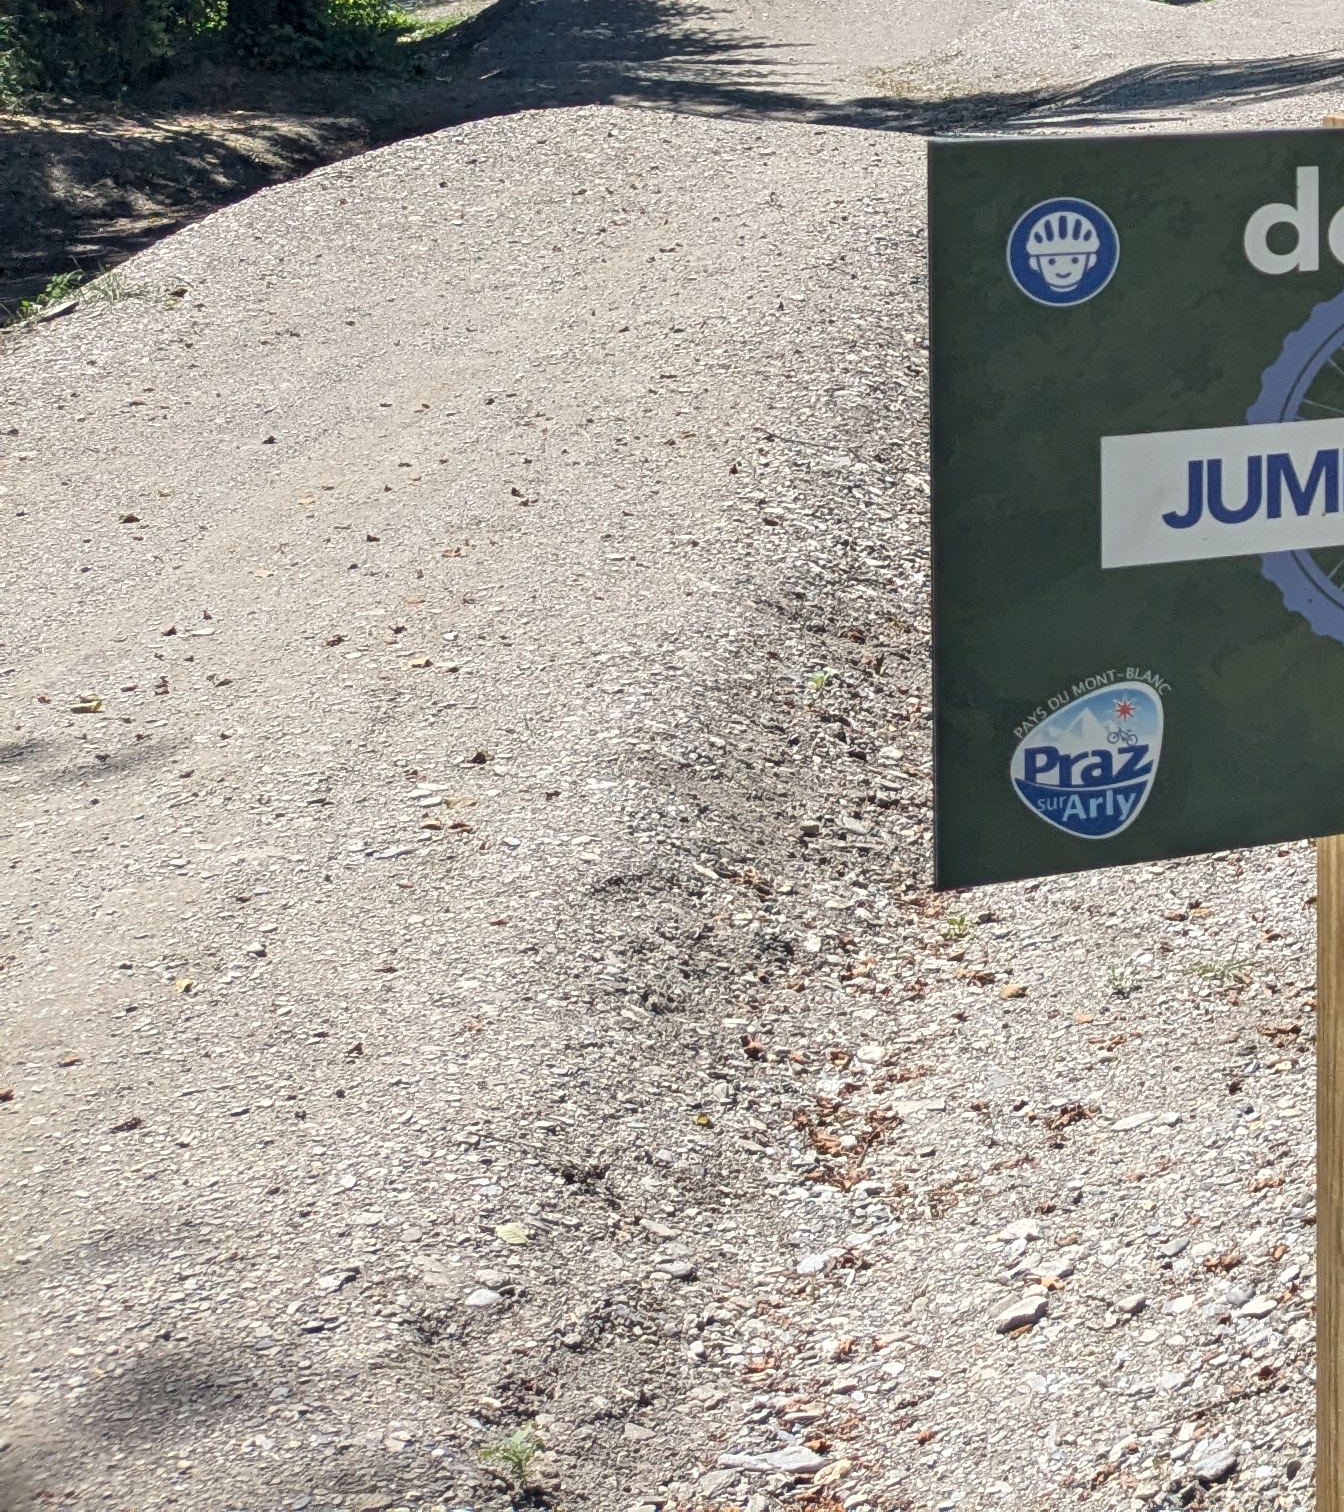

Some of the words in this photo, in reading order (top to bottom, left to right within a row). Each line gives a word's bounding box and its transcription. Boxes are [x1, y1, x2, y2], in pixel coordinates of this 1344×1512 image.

[1013, 708, 1047, 738] PAYS
[1047, 690, 1070, 711] DU
[1072, 666, 1172, 697] MONT-BLANC
[1024, 744, 1154, 788] Praz
[1036, 795, 1067, 812] sur
[1062, 789, 1137, 821] Arly
